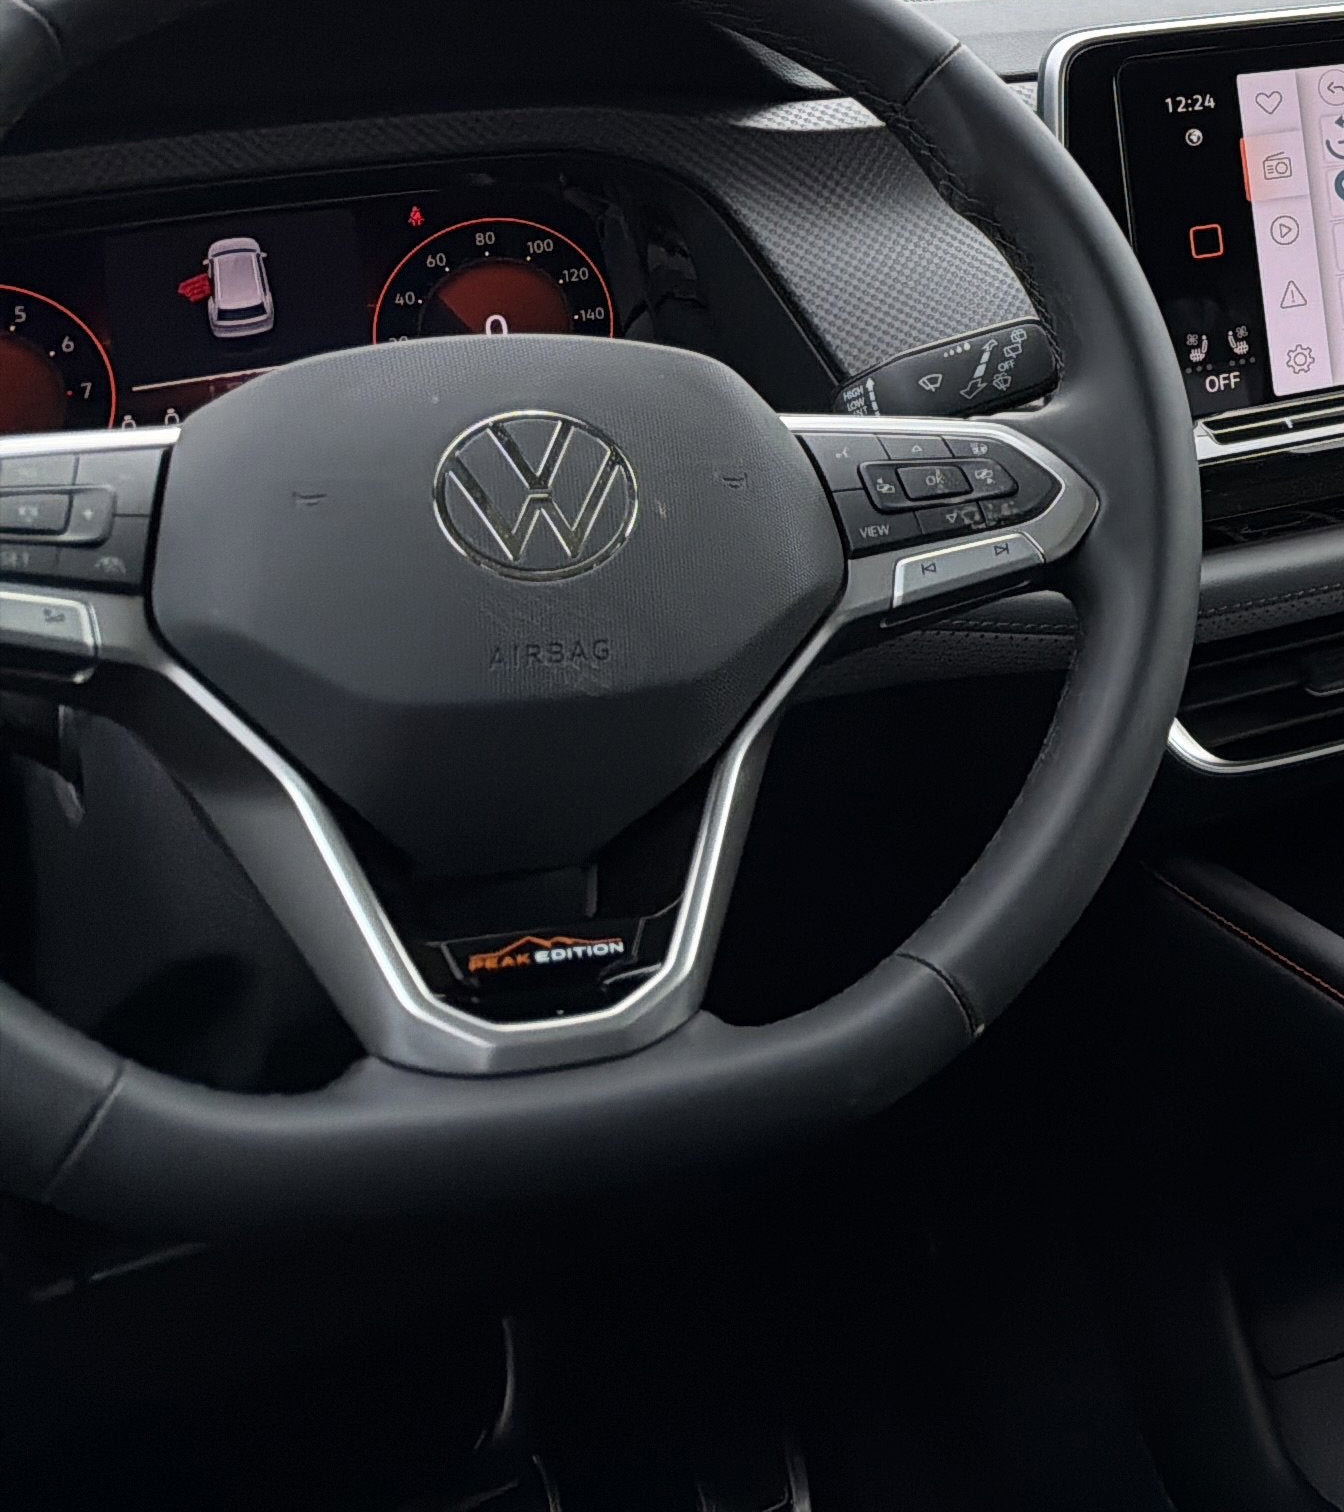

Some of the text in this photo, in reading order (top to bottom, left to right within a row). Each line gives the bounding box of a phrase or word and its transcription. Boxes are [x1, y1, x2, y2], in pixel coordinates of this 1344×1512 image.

[1165, 93, 1216, 113] 12:24
[475, 232, 495, 245] 80
[527, 239, 554, 253] 100
[426, 253, 446, 267] 60
[562, 267, 589, 282] 120
[395, 292, 415, 305] 40
[14, 306, 26, 323] 5
[579, 308, 604, 321] 140
[61, 336, 75, 352] 6
[1204, 372, 1241, 394] OFF
[80, 383, 92, 399] 7
[843, 385, 864, 401] HIGH
[847, 397, 865, 411] LOW
[859, 524, 891, 538] VIEW
[490, 639, 610, 669] AIRBAG
[468, 941, 625, 972] PEAK EDITION
